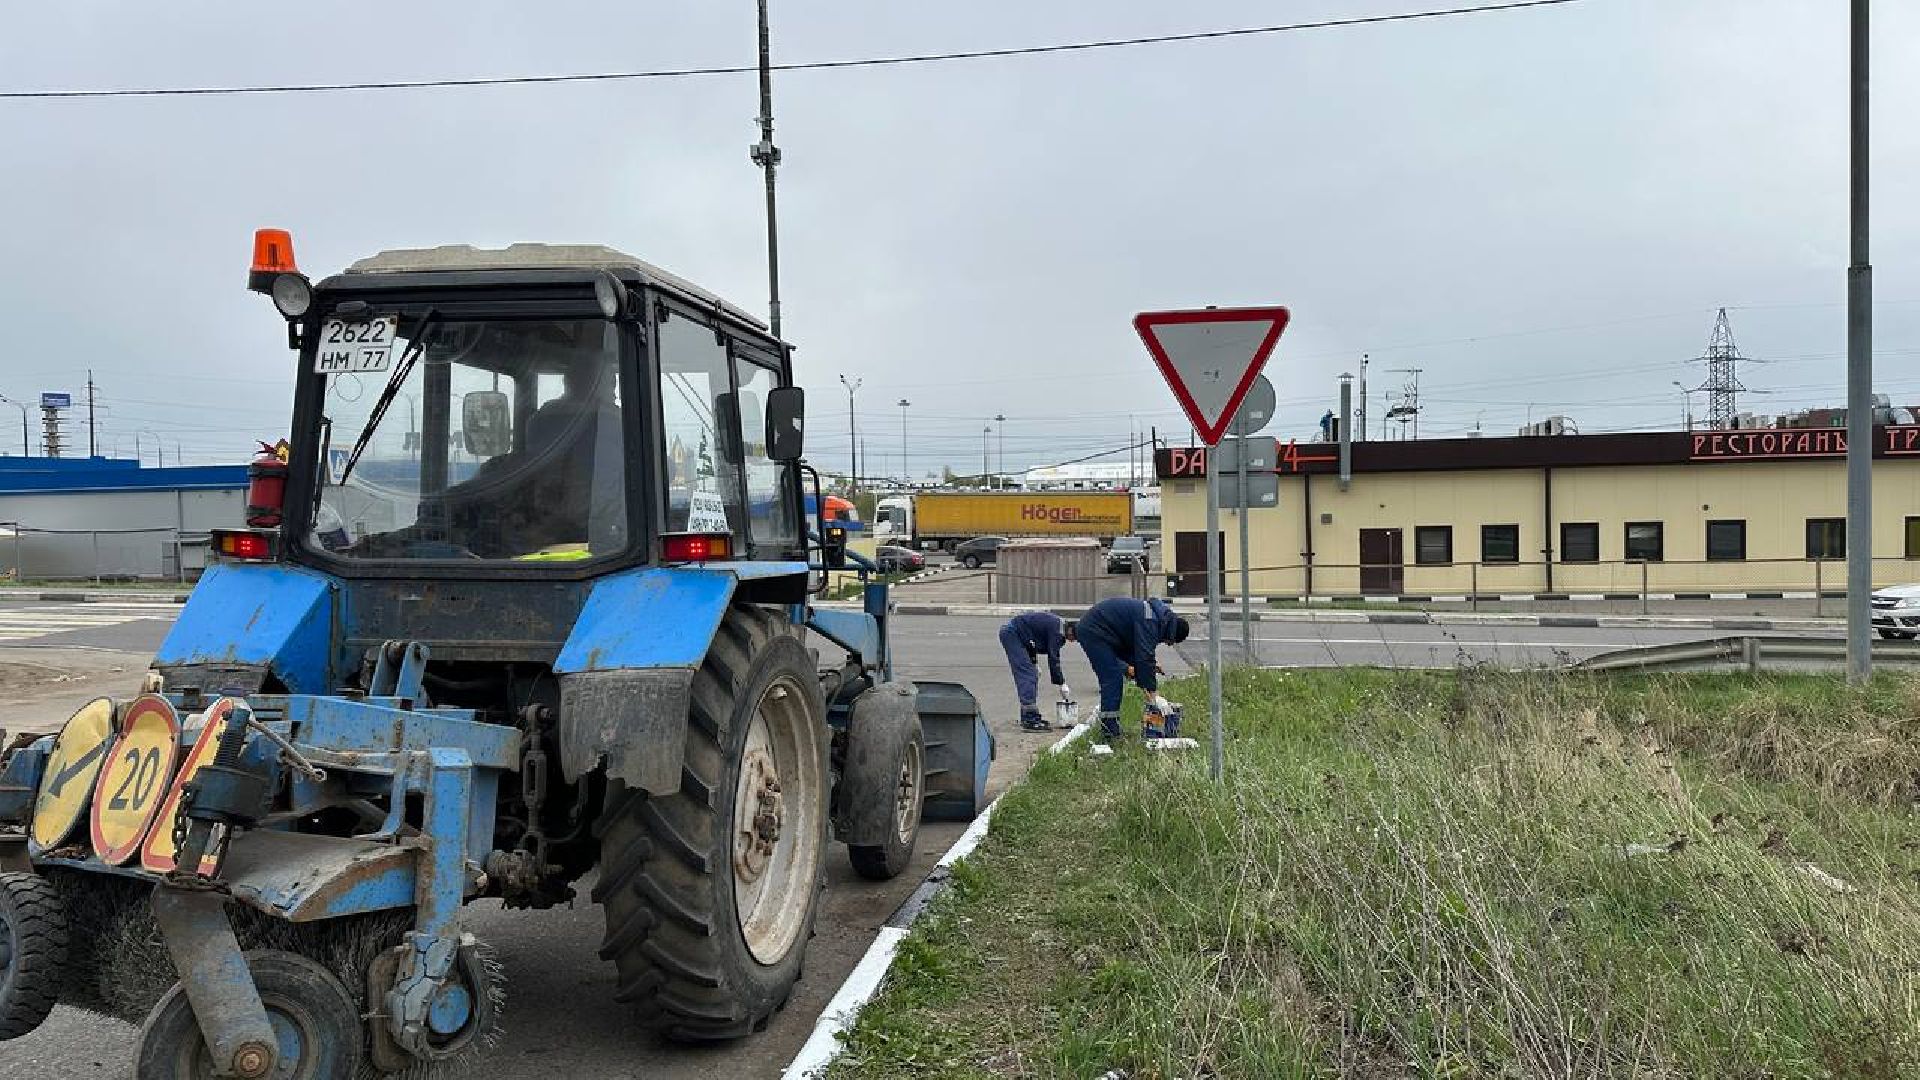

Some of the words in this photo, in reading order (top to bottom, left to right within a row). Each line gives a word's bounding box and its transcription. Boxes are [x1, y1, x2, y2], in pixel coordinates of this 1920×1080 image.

[328, 321, 386, 343] 2622
[321, 351, 350, 370] НМ
[363, 351, 385, 368] 77
[108, 747, 160, 811] 20
